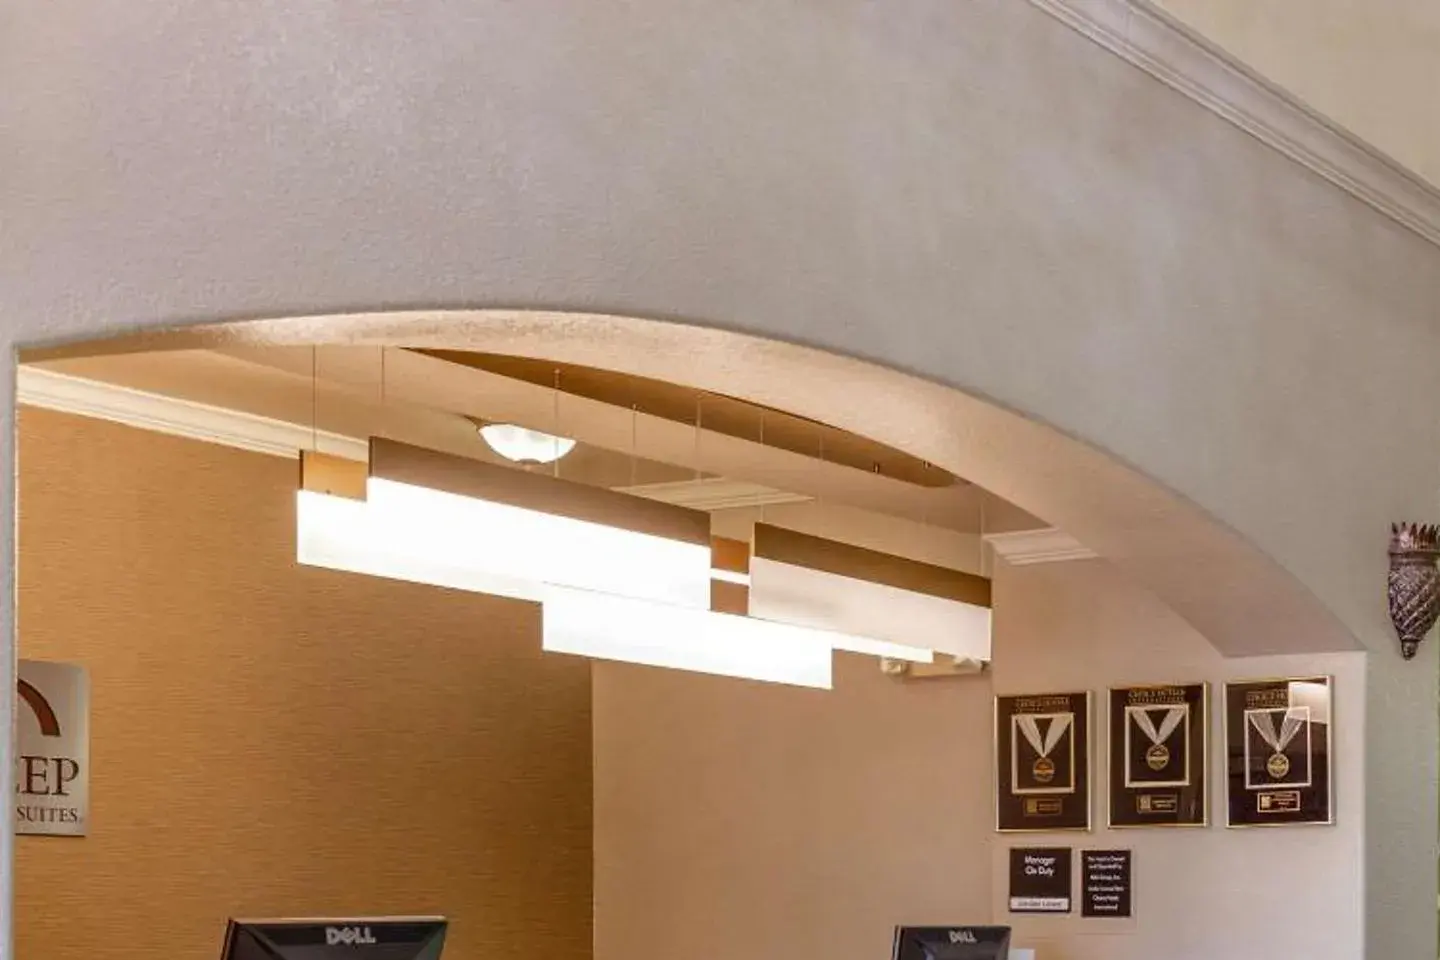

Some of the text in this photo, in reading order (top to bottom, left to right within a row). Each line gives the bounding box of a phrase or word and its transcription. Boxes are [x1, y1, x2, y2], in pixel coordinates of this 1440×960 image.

[16, 806, 79, 823] SUITES
[1024, 856, 1056, 866] Manager
[1024, 866, 1055, 876] On Duty
[325, 926, 377, 945] DELL
[948, 930, 977, 943] DELL
